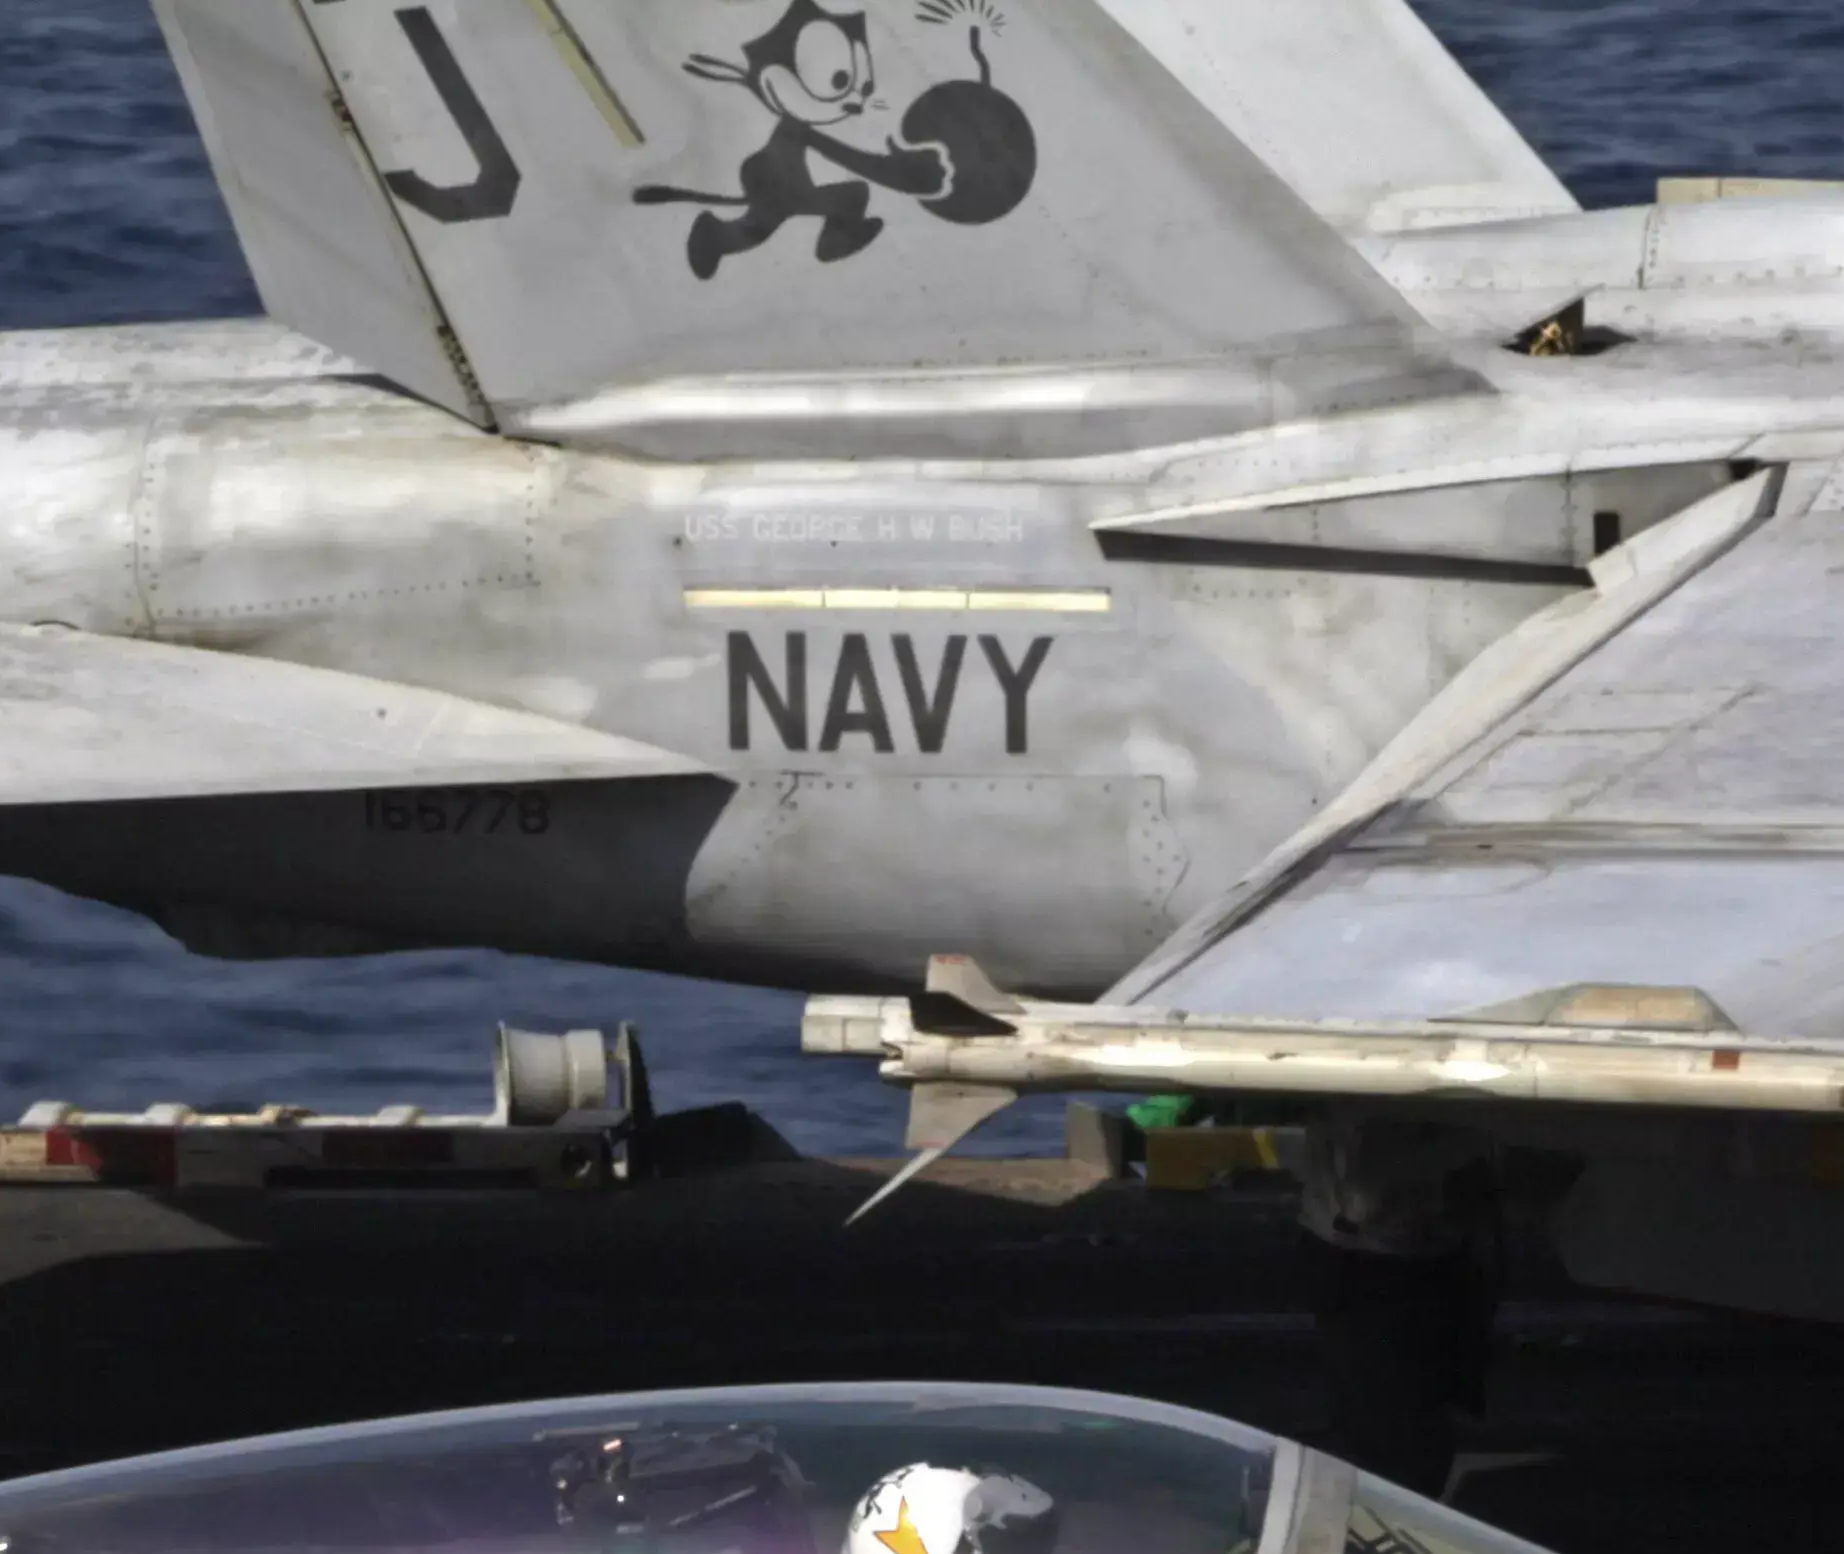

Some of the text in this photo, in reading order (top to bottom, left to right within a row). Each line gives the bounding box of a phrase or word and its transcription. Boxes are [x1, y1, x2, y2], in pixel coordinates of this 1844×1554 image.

[683, 514, 739, 541] USS
[877, 514, 897, 542] H
[910, 514, 935, 542] W
[948, 513, 1024, 542] BUSH
[727, 630, 1055, 754] NAVY
[364, 788, 552, 835] 166778
